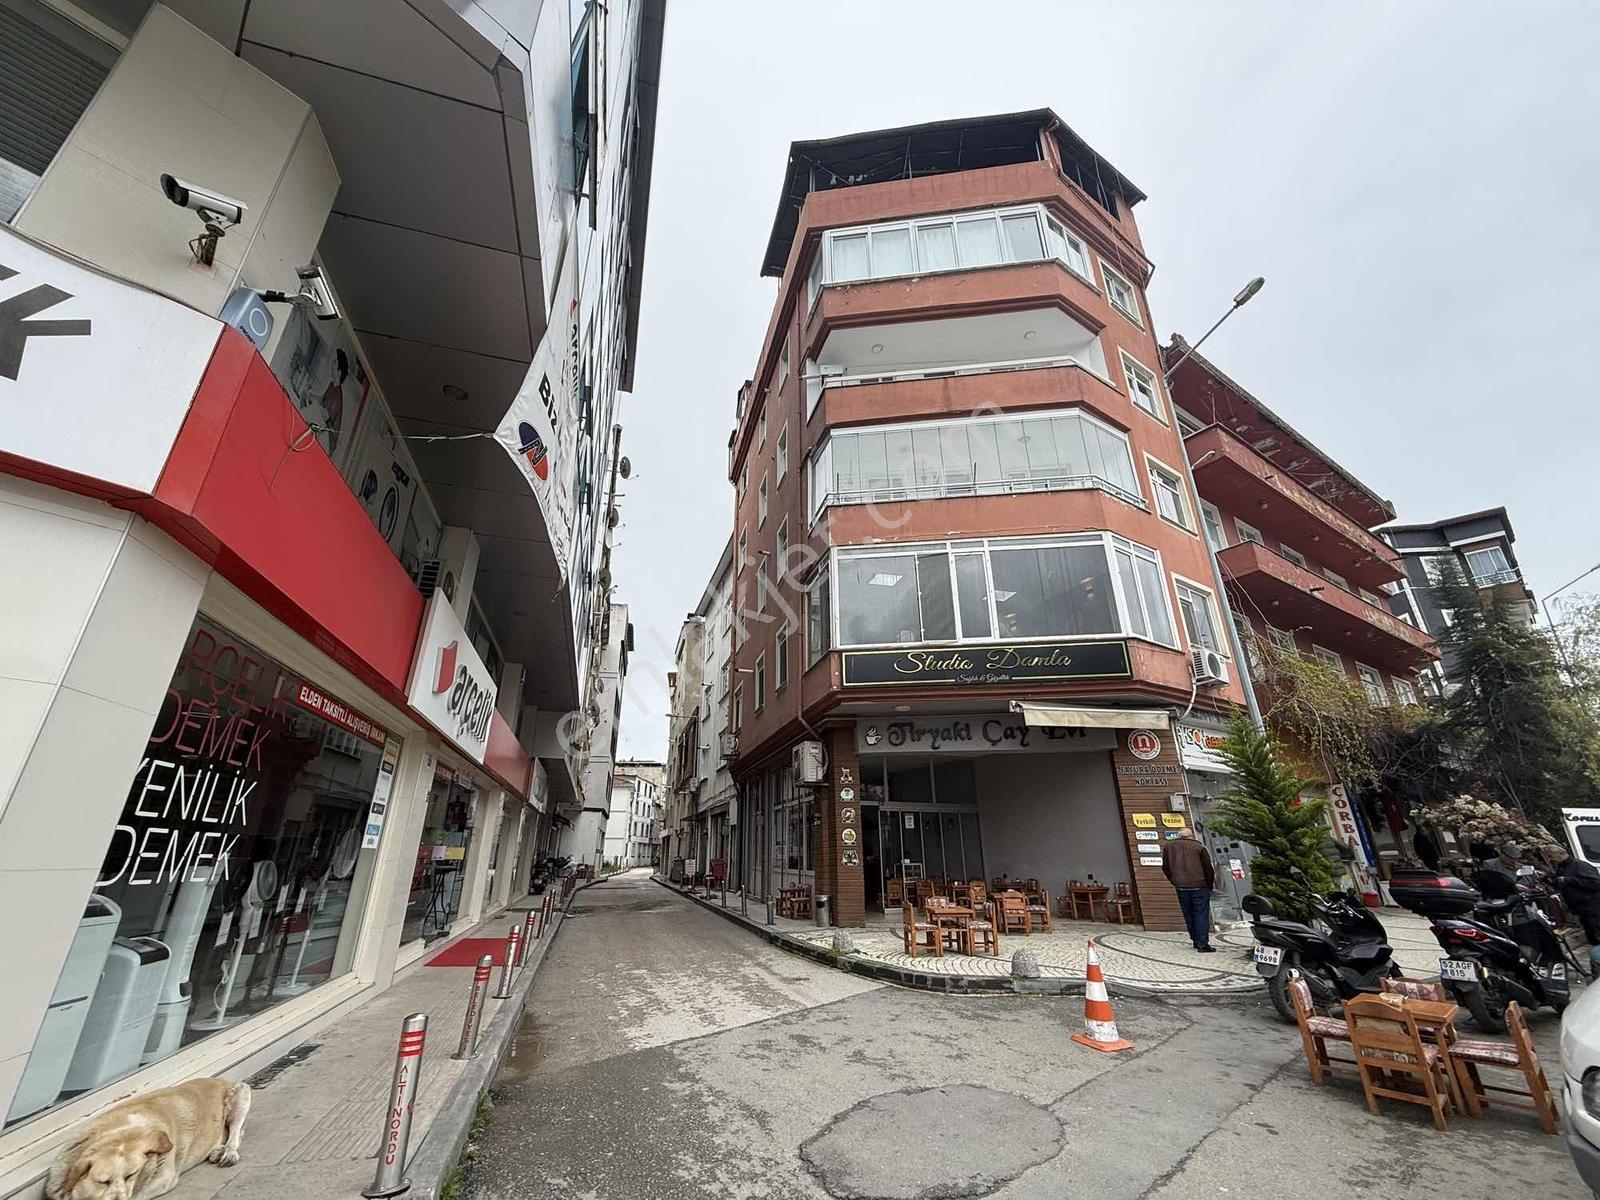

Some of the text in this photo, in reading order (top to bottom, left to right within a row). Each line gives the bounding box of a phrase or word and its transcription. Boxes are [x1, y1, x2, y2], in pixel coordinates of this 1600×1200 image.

[893, 646, 1073, 674] Studio Damla
[299, 686, 323, 710] ELDEN
[322, 697, 348, 724] TAKSİTLİ
[887, 721, 973, 750] Tiryaki
[981, 720, 1030, 748] Çay
[95, 824, 241, 887] DEMEK
[1442, 960, 1454, 969] 52
[385, 1064, 409, 1166] ALTINORDU
